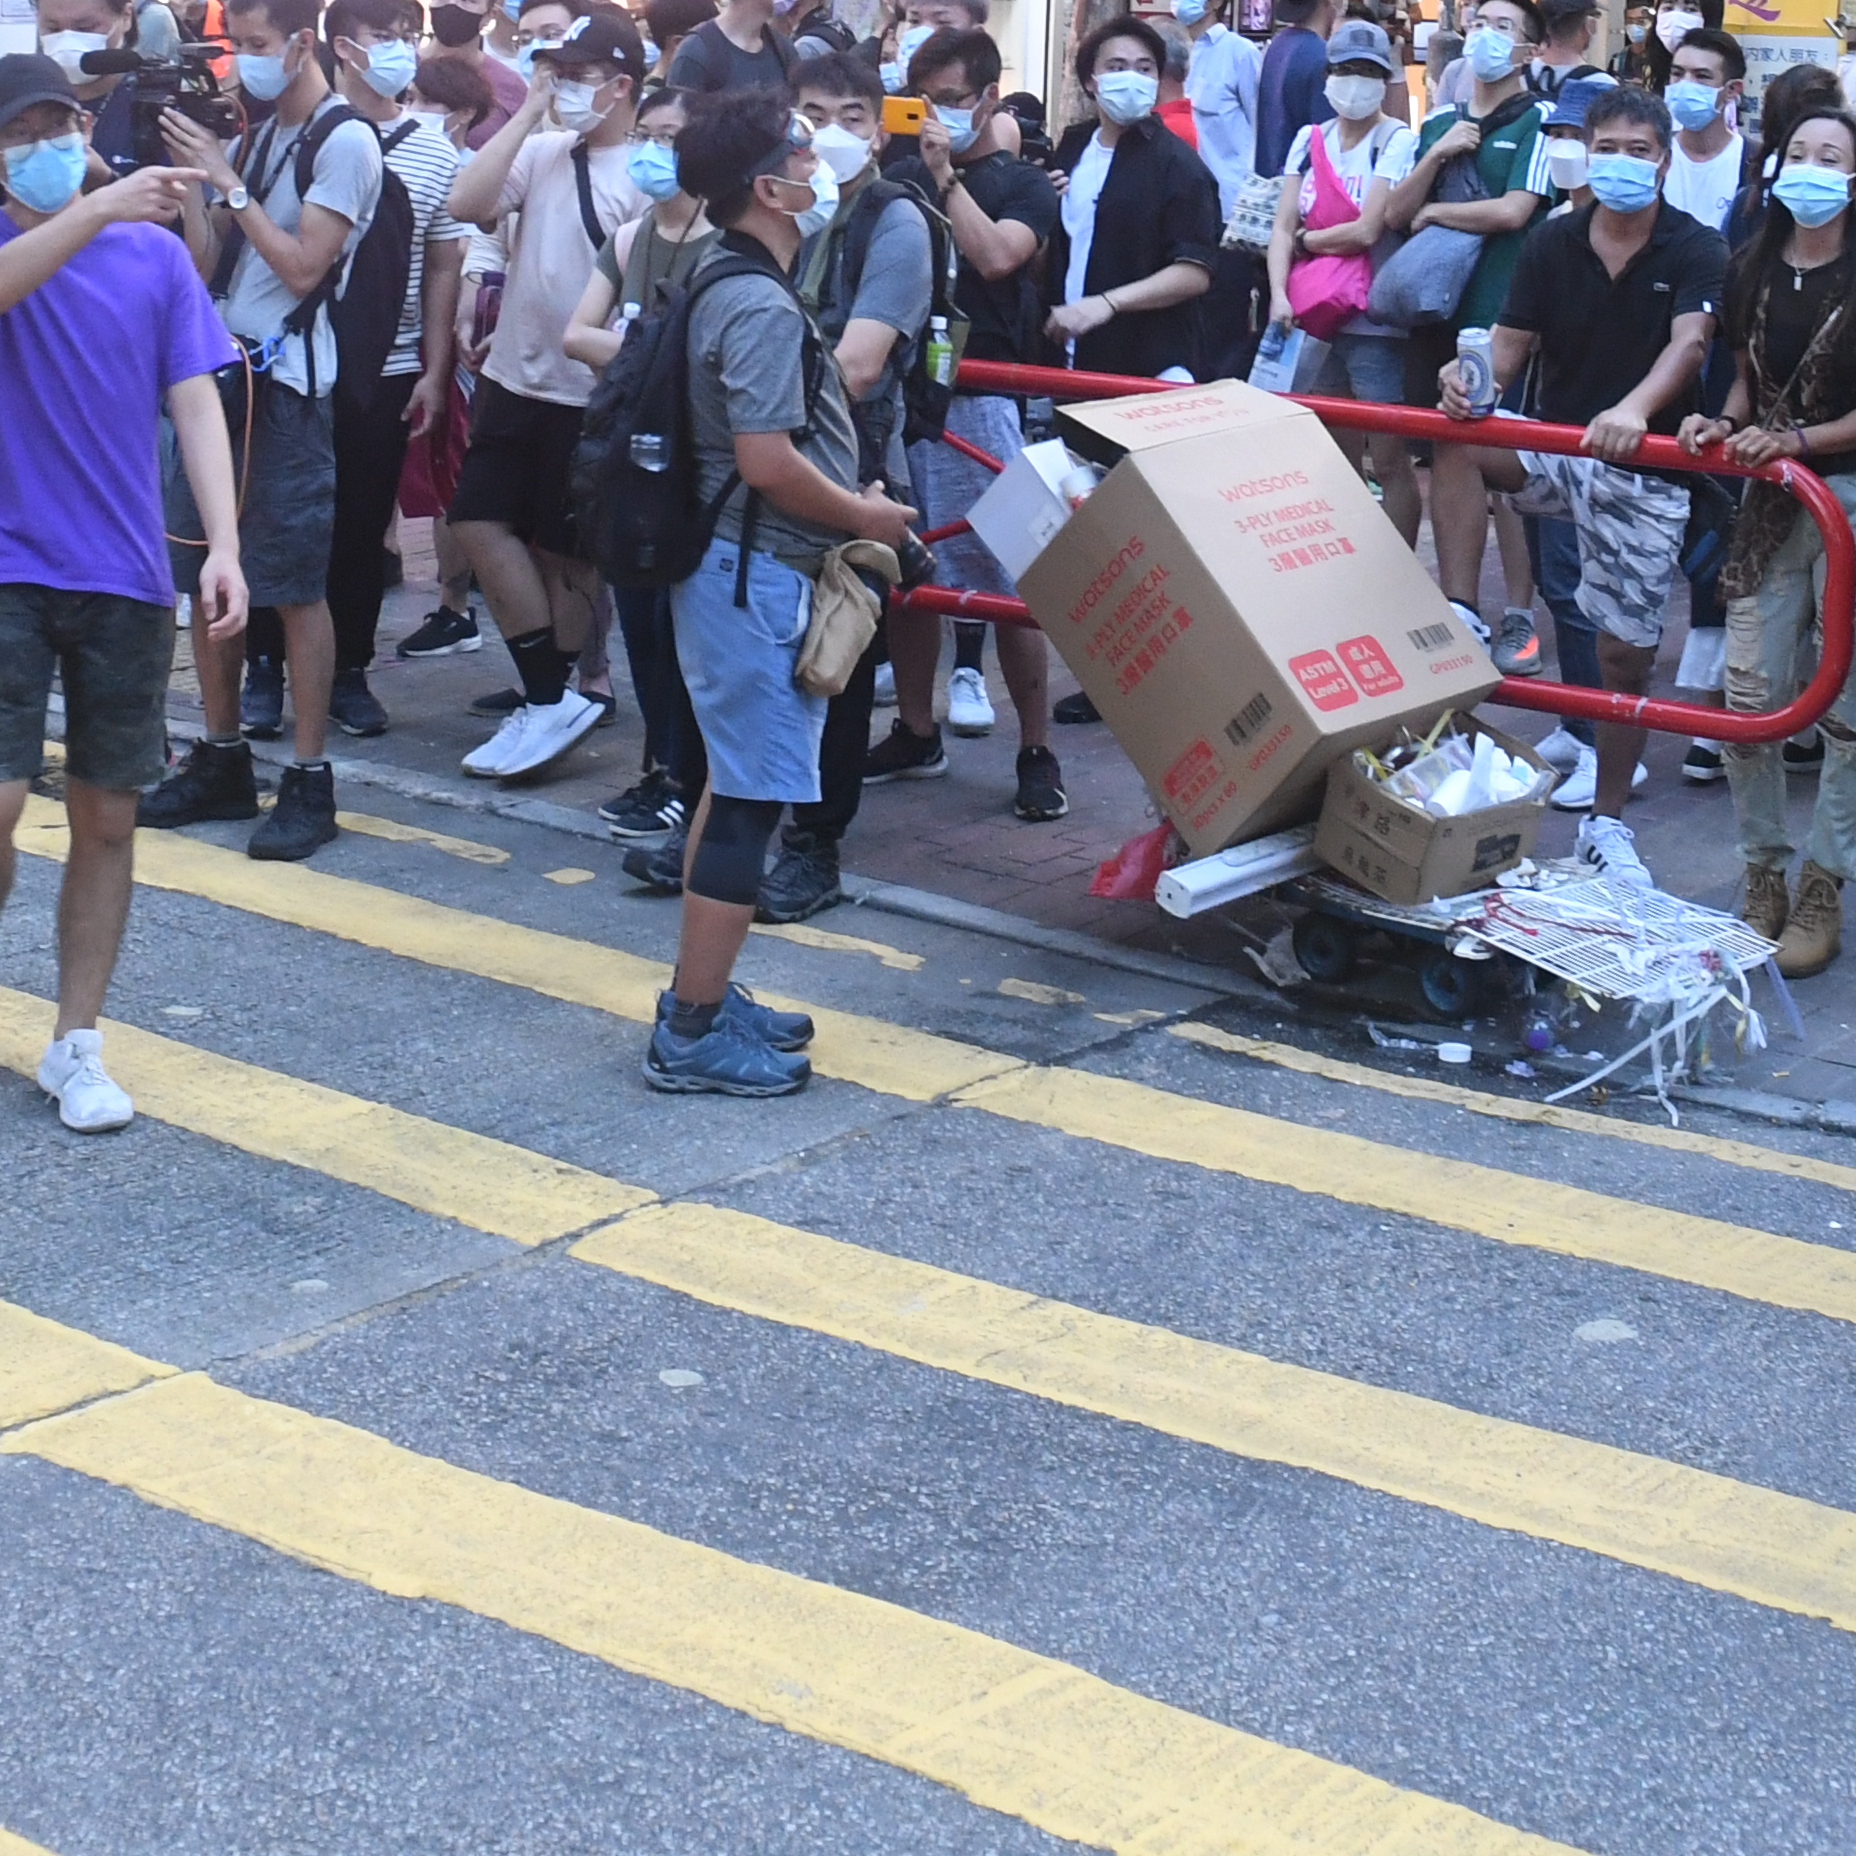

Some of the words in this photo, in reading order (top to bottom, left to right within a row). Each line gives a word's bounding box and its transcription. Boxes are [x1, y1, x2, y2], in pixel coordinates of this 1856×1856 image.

[1113, 394, 1225, 421] watsons
[1218, 469, 1309, 504] watsons
[1234, 516, 1273, 537] 3-PLY
[1274, 498, 1335, 529] MEDICAL
[1259, 528, 1295, 550] FACE
[1297, 518, 1336, 541] MASK
[1068, 535, 1145, 625] watsons
[1114, 563, 1171, 626] MEDICAL
[1105, 630, 1136, 669] FACE
[1132, 591, 1173, 637] MASK
[1298, 659, 1338, 684] ASTM
